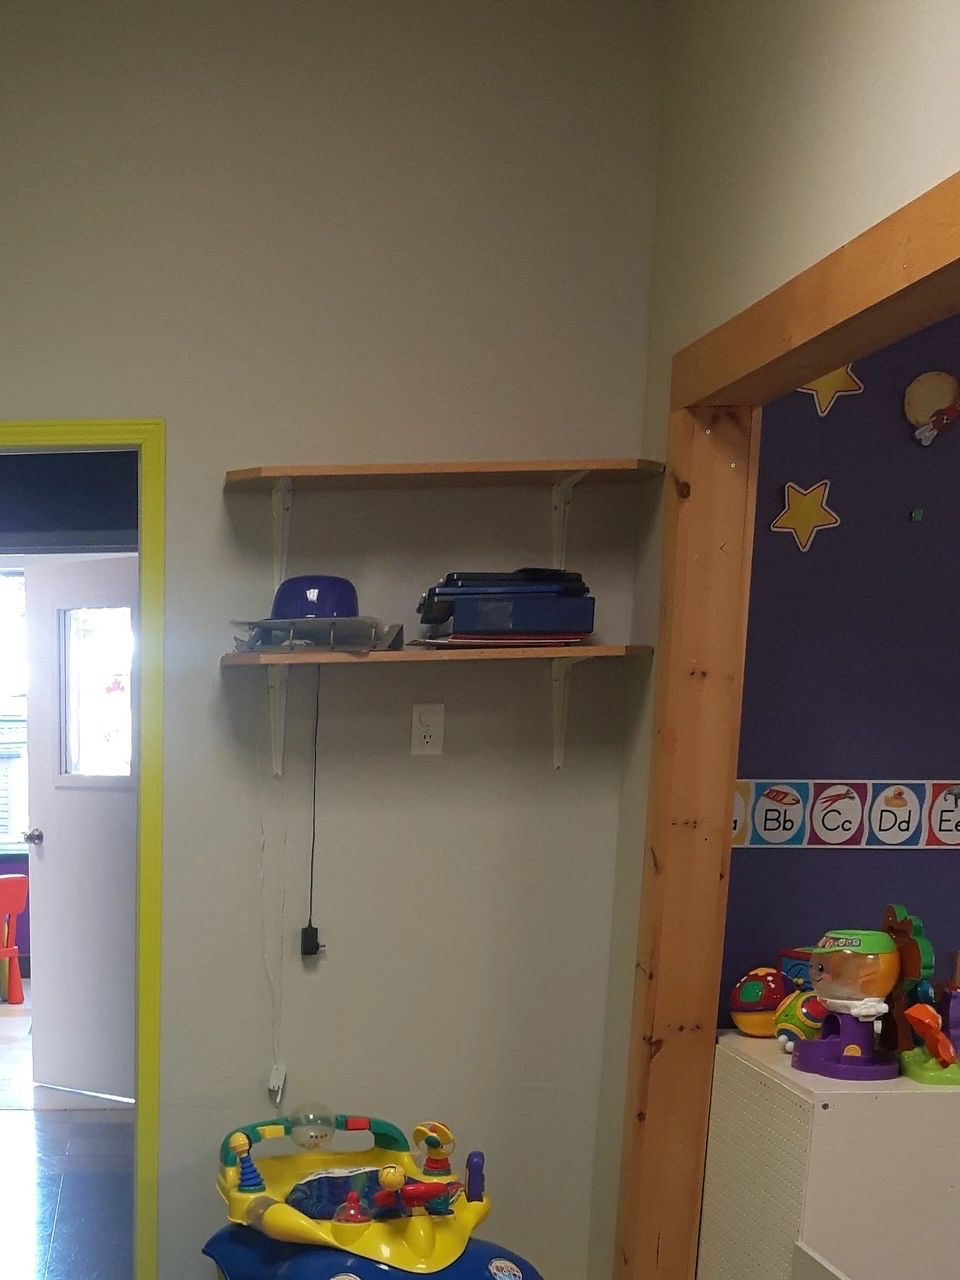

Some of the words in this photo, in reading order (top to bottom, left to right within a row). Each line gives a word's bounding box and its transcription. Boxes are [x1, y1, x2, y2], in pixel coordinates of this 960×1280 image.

[763, 808, 795, 832] Bb
[821, 809, 853, 832] Cc
[878, 809, 913, 832] Dd
